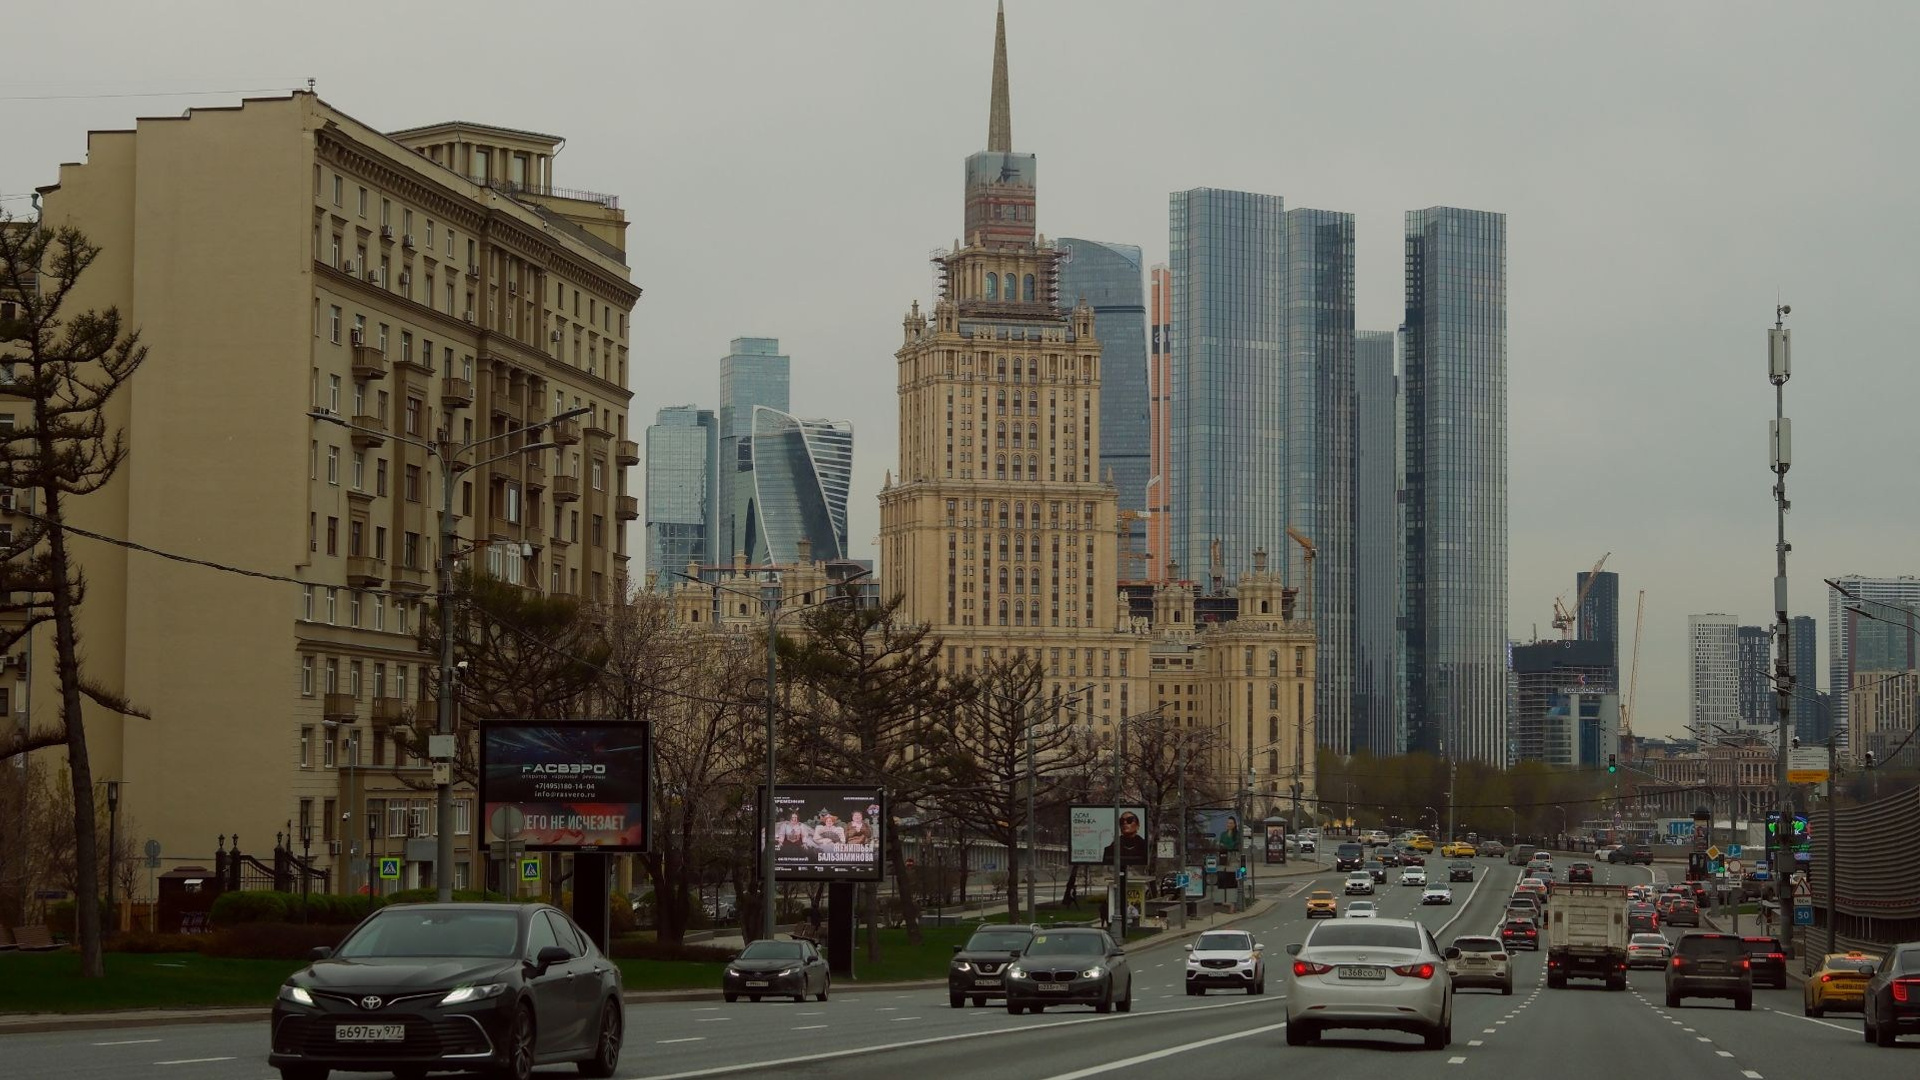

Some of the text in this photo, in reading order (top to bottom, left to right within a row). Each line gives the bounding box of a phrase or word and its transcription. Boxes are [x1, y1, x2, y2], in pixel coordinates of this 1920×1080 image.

[523, 815, 626, 831] ЕГО НЕ ИСЧЕЗАЕТ
[817, 852, 874, 862] БАЛЬЗАМИНОВА
[1797, 911, 1809, 920] 50
